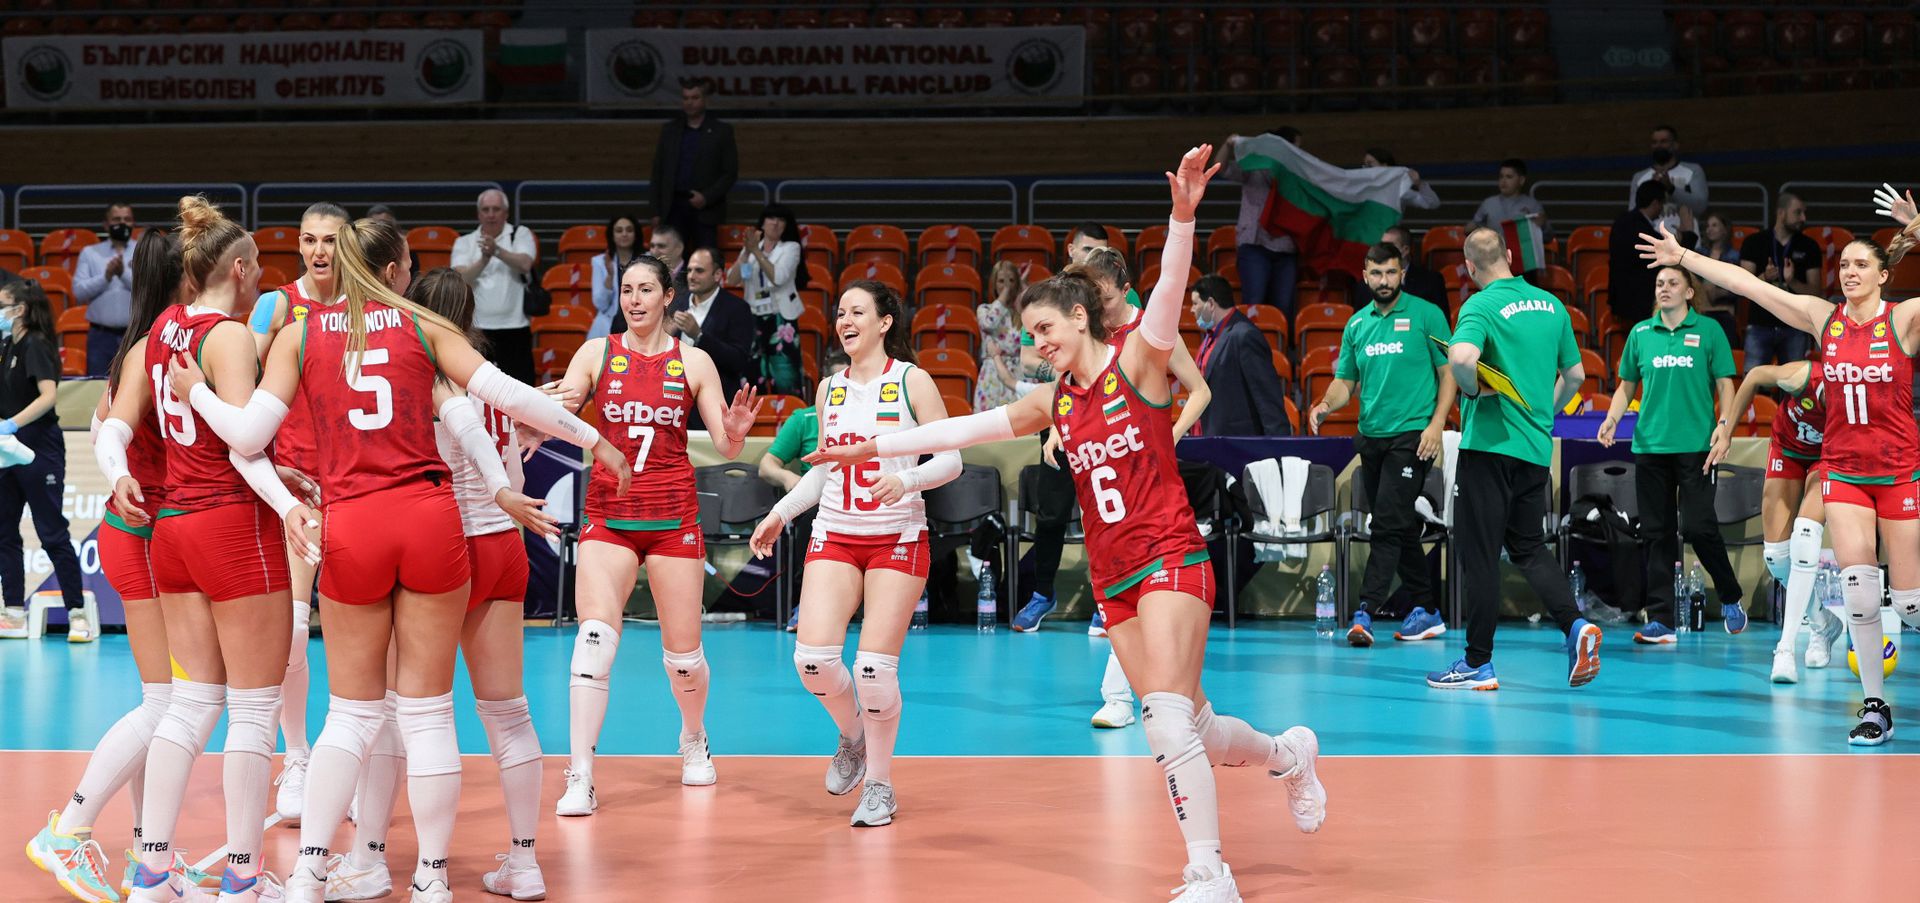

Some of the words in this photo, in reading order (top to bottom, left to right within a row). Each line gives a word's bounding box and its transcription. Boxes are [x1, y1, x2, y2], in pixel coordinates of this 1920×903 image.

[83, 44, 224, 66] БЪЛГАРСКИ
[240, 40, 405, 67] НАЦИОНАЛЕН
[682, 45, 844, 66] BULGARIAN
[853, 44, 993, 65] NATIONAL
[100, 76, 256, 100] ВОЛЕЙБОЛЕН
[275, 75, 386, 98] ФЕНКЛУБ
[864, 75, 992, 95] FANCLUB
[320, 308, 402, 333] YORNOVA
[1499, 299, 1555, 320] BULGARIA
[1365, 341, 1404, 357] efbet
[1652, 354, 1694, 369] efbet
[1823, 361, 1893, 383] efbet
[345, 348, 393, 430] 5
[602, 400, 684, 428] efbet
[1843, 384, 1868, 425] 11
[628, 425, 656, 473] 7
[1066, 423, 1145, 475] efbet
[1771, 458, 1784, 472] 16
[841, 461, 880, 511] 15
[1090, 465, 1126, 524] 6
[1167, 774, 1188, 821] IRONMAN
[228, 852, 252, 865] rrea
